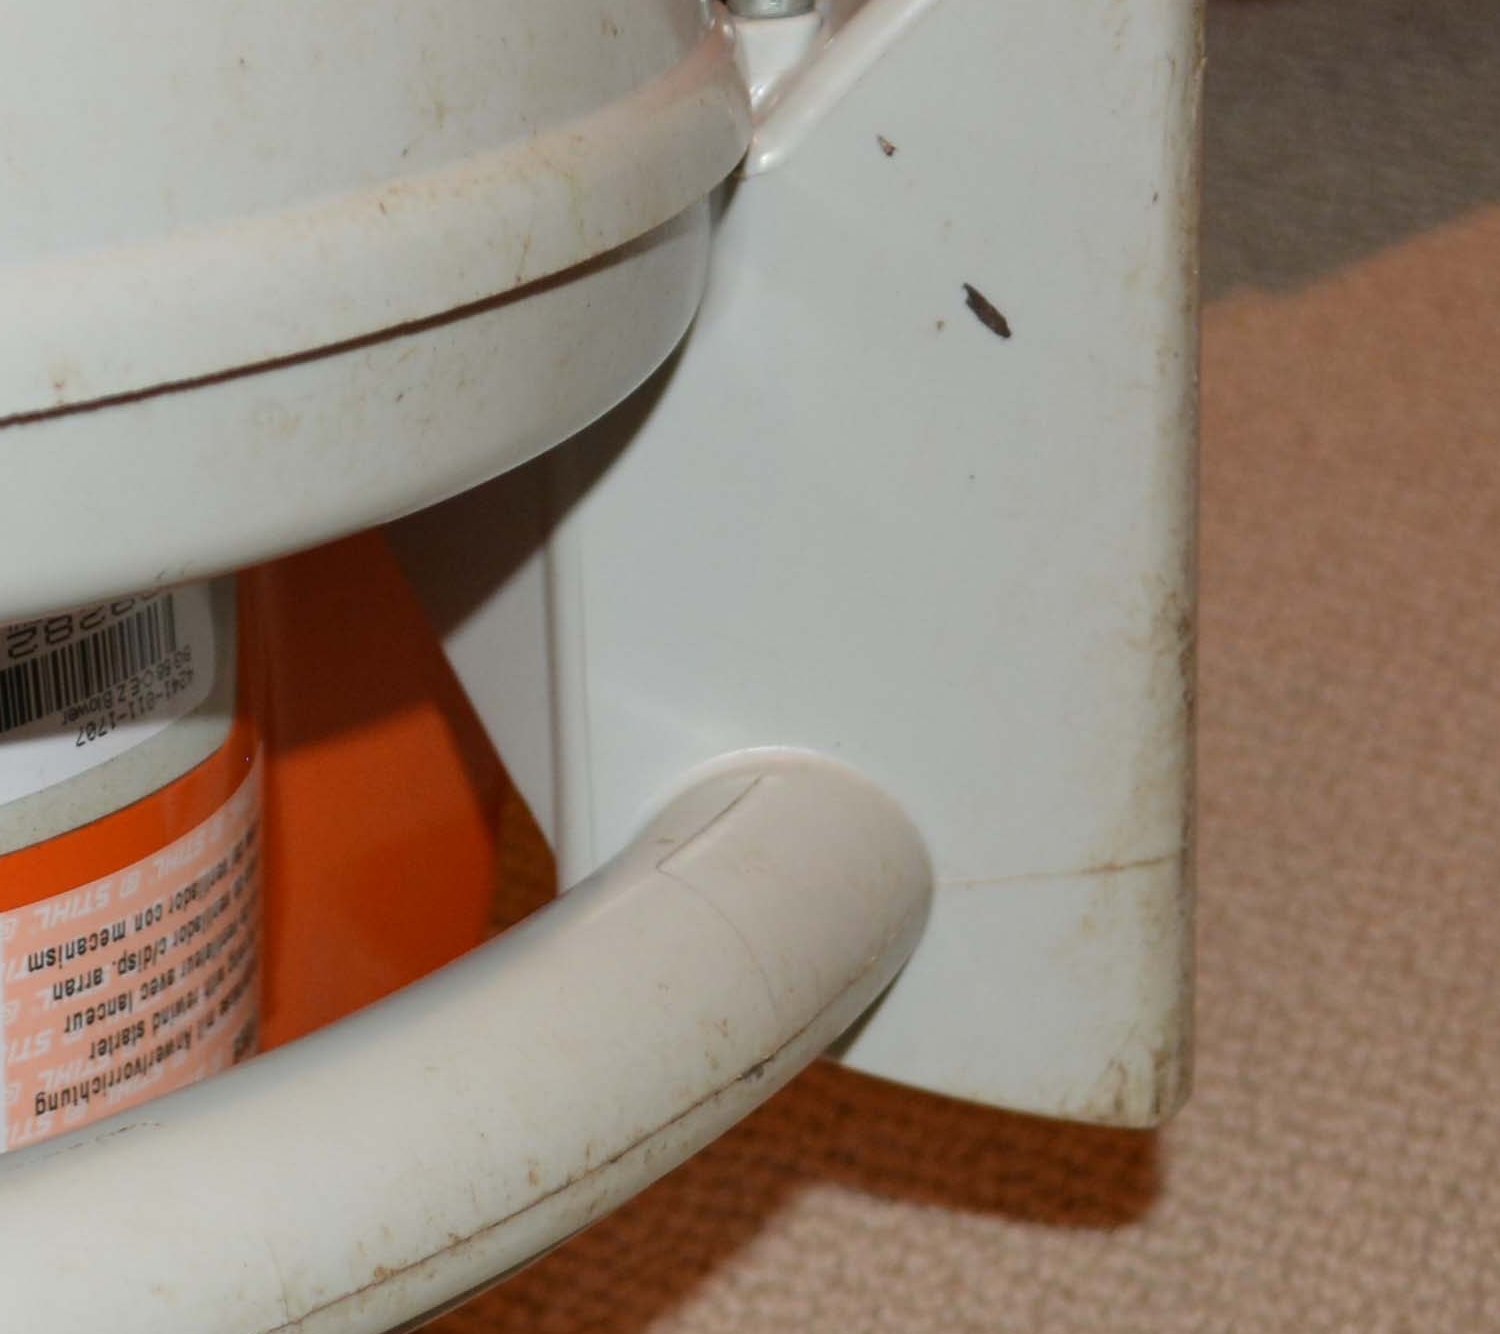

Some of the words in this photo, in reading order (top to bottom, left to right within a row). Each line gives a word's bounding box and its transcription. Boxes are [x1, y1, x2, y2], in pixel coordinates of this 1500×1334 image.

[28, 920, 125, 973] mecanism
[112, 937, 167, 975] c/disp.
[53, 968, 102, 1001] arran
[140, 969, 175, 1001] avec
[64, 991, 132, 1035] lanceur
[90, 1019, 144, 1060] starter
